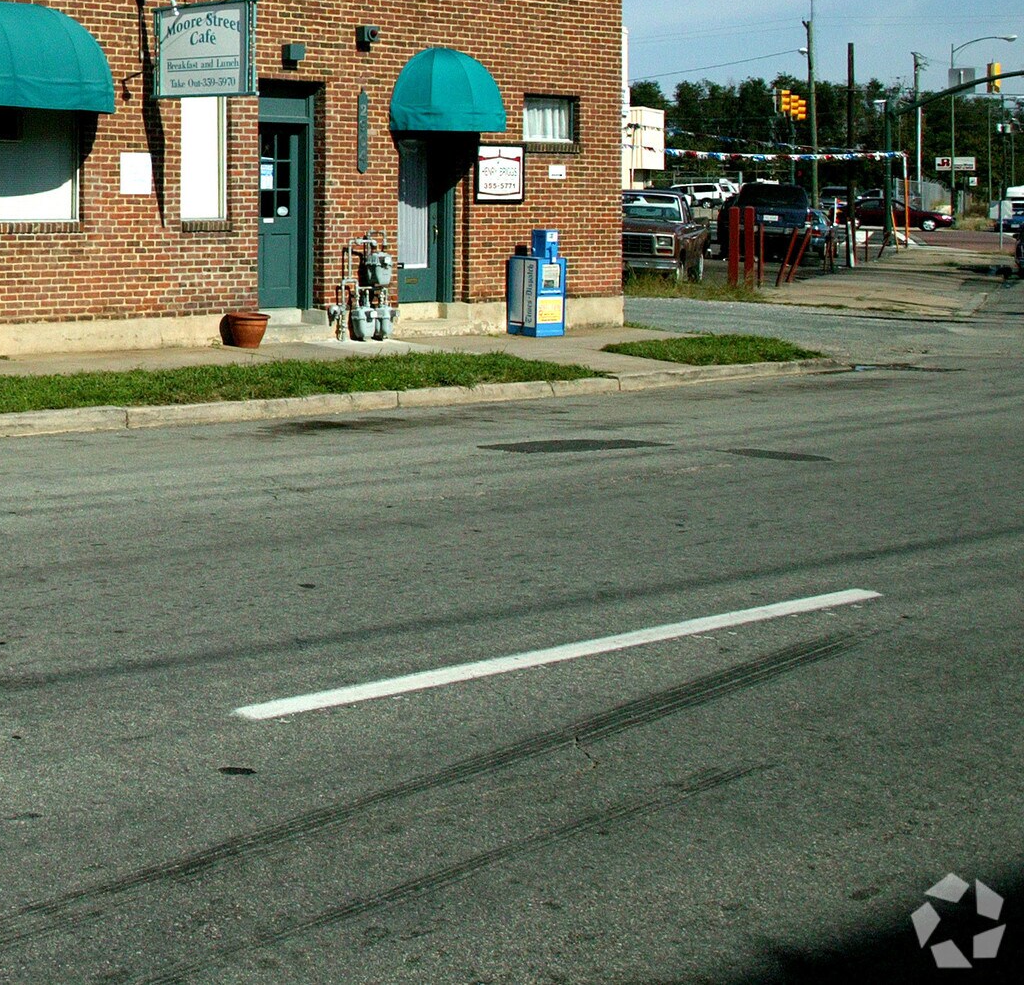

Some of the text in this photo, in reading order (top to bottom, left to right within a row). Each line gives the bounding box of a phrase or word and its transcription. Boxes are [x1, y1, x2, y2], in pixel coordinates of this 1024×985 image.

[166, 13, 241, 38] Moore Street
[167, 58, 239, 70] Breakfast and Lunch
[170, 79, 186, 88] Take
